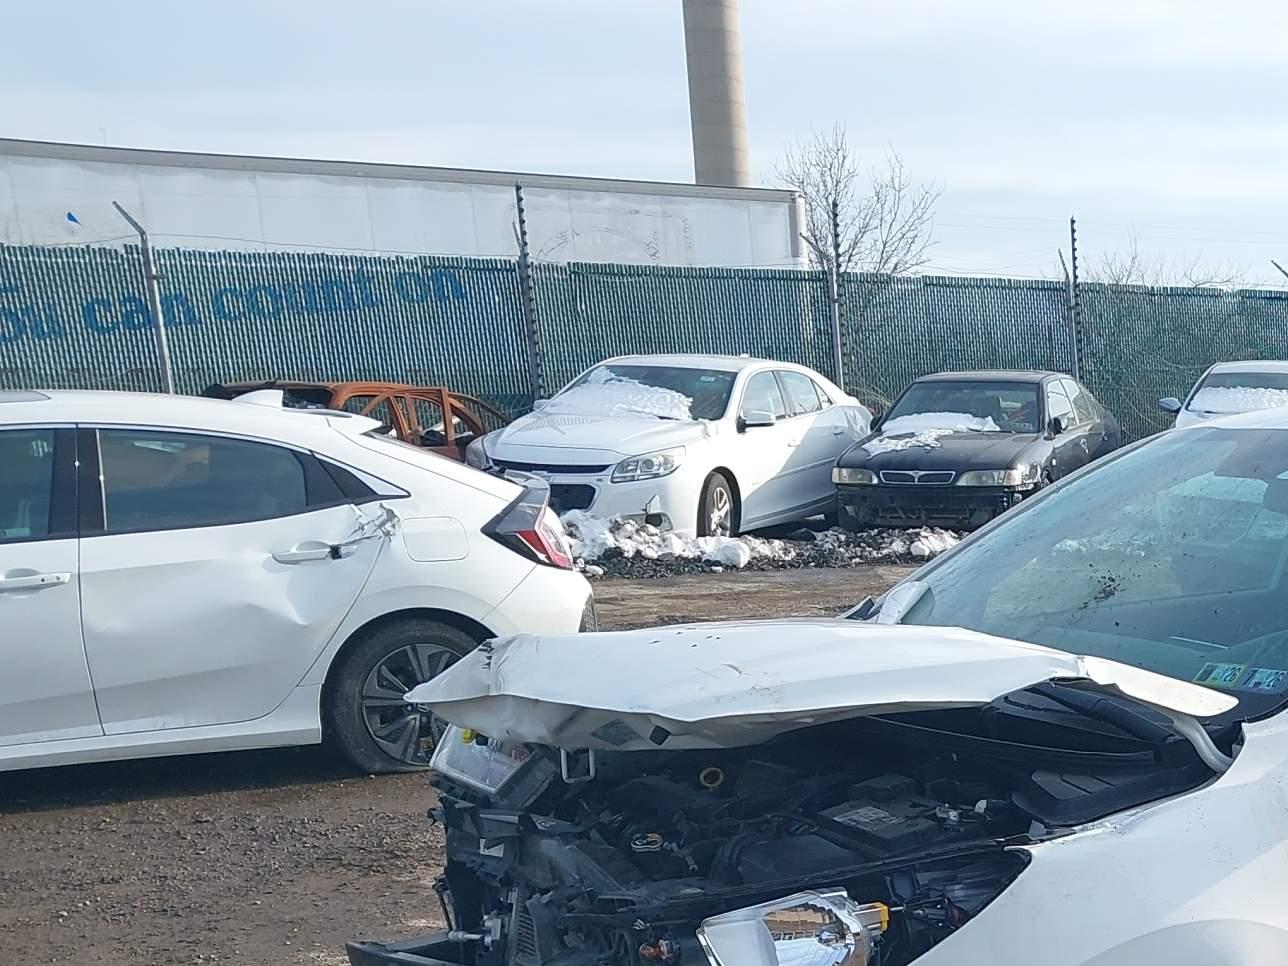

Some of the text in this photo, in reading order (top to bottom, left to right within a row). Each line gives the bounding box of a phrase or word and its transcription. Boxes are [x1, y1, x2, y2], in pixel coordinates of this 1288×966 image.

[0, 267, 467, 343] ou can count on
